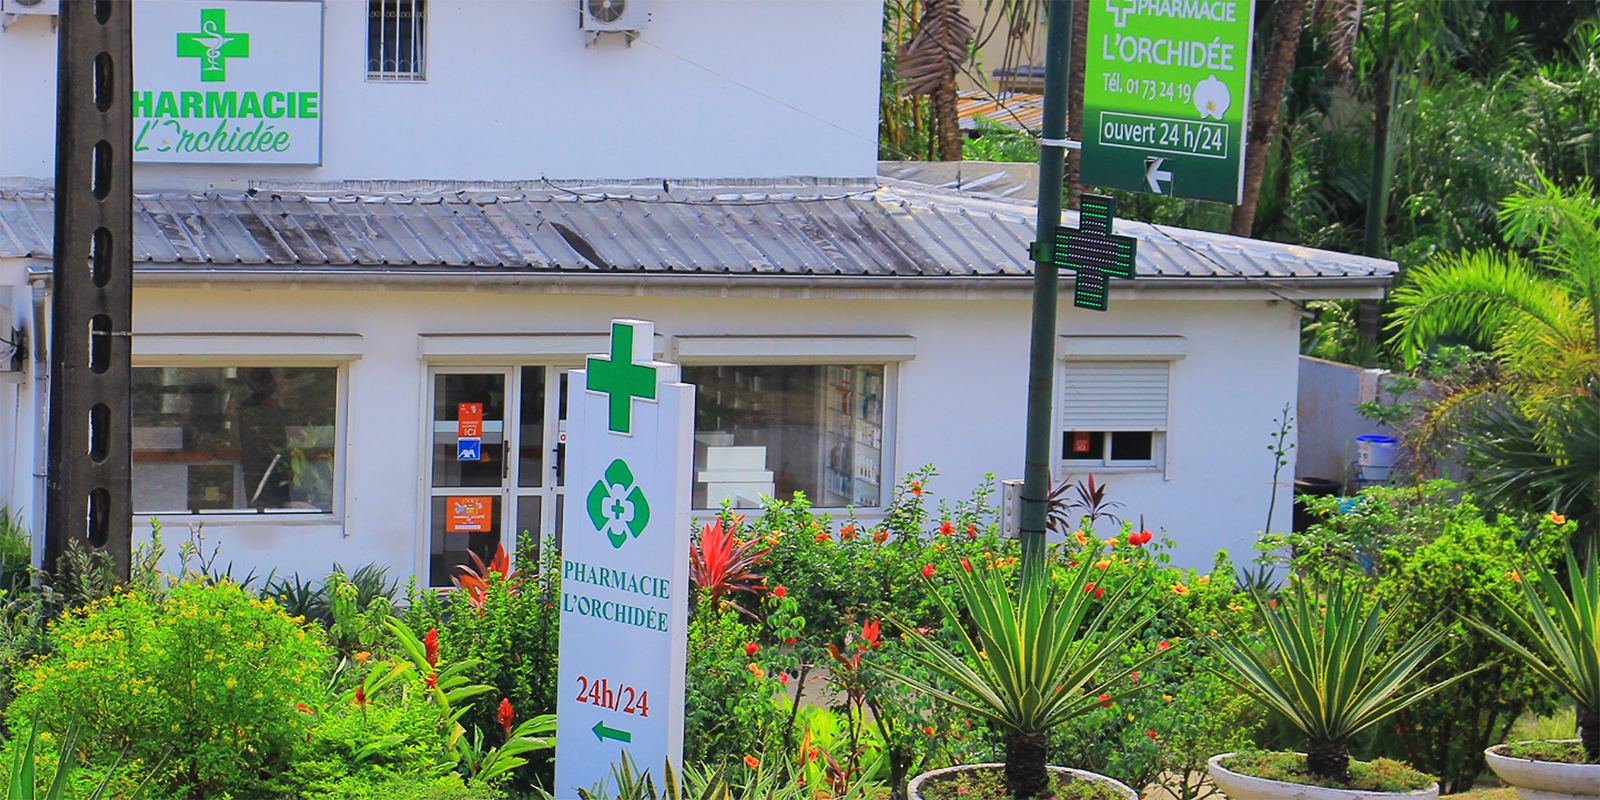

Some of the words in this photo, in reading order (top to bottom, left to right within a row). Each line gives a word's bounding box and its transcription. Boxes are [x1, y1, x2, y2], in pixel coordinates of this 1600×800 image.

[1138, 0, 1236, 22] PHARMACIE
[1102, 34, 1234, 71] L'ORCHIDÉE
[132, 91, 318, 118] HARMACIE
[1103, 73, 1123, 93] Tél.
[1127, 78, 1139, 94] 01
[1142, 80, 1157, 100] 73
[1160, 82, 1174, 102] 24
[1178, 84, 1192, 104] 19
[1104, 121, 1156, 144] ouvert
[1159, 123, 1179, 146] 24
[564, 560, 670, 599] PHARMACIE
[563, 593, 668, 632] L'ORCHIDÉE
[576, 675, 649, 717] 24h/24
